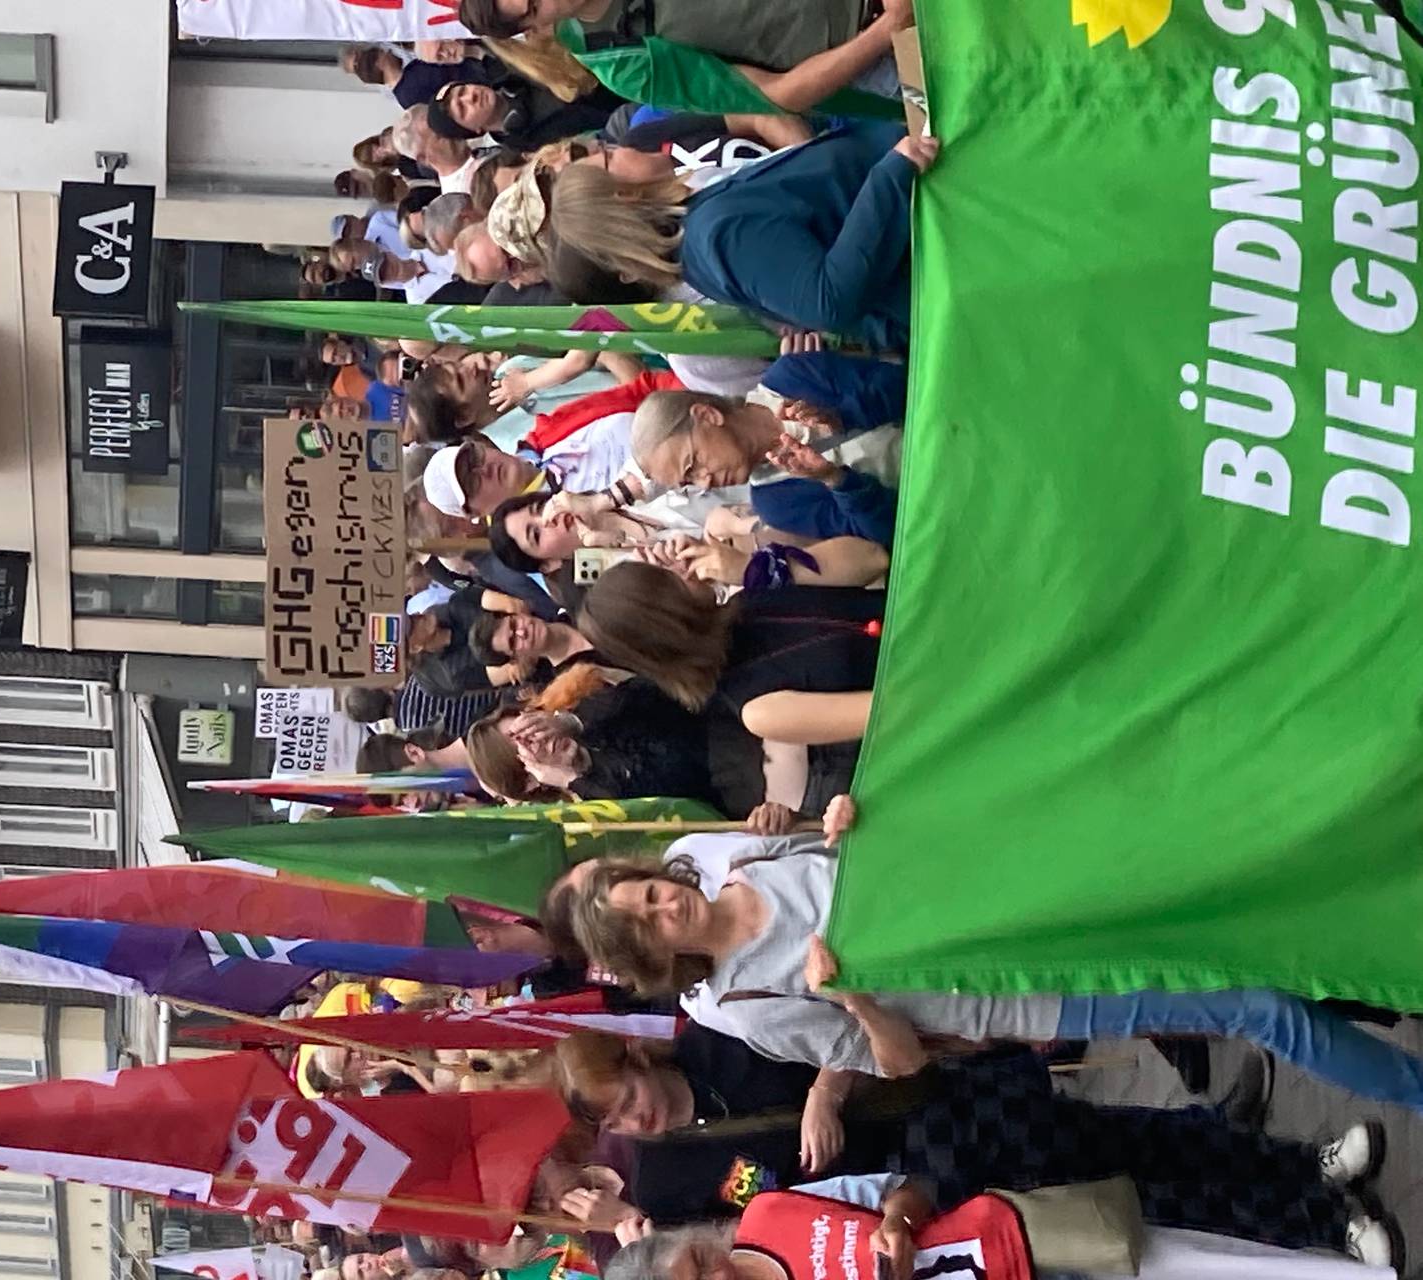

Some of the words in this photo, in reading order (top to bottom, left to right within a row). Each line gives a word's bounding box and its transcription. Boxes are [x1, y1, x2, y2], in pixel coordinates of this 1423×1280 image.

[1306, 0, 1420, 334] GRÜNE
[74, 201, 135, 295] C&A
[1179, 66, 1303, 516] BÜNDNIS
[88, 387, 131, 458] PERFECT
[1320, 368, 1417, 546] DIE
[371, 477, 394, 530] NZS
[321, 431, 365, 678] Faschismus
[370, 537, 394, 607] FCK
[383, 645, 396, 672] NZS
[260, 692, 274, 734] OMAS
[279, 715, 299, 769] OMAS
[297, 715, 315, 771] GEGEN
[312, 715, 330, 772] RECHTS
[809, 1214, 831, 1280] echtigt,
